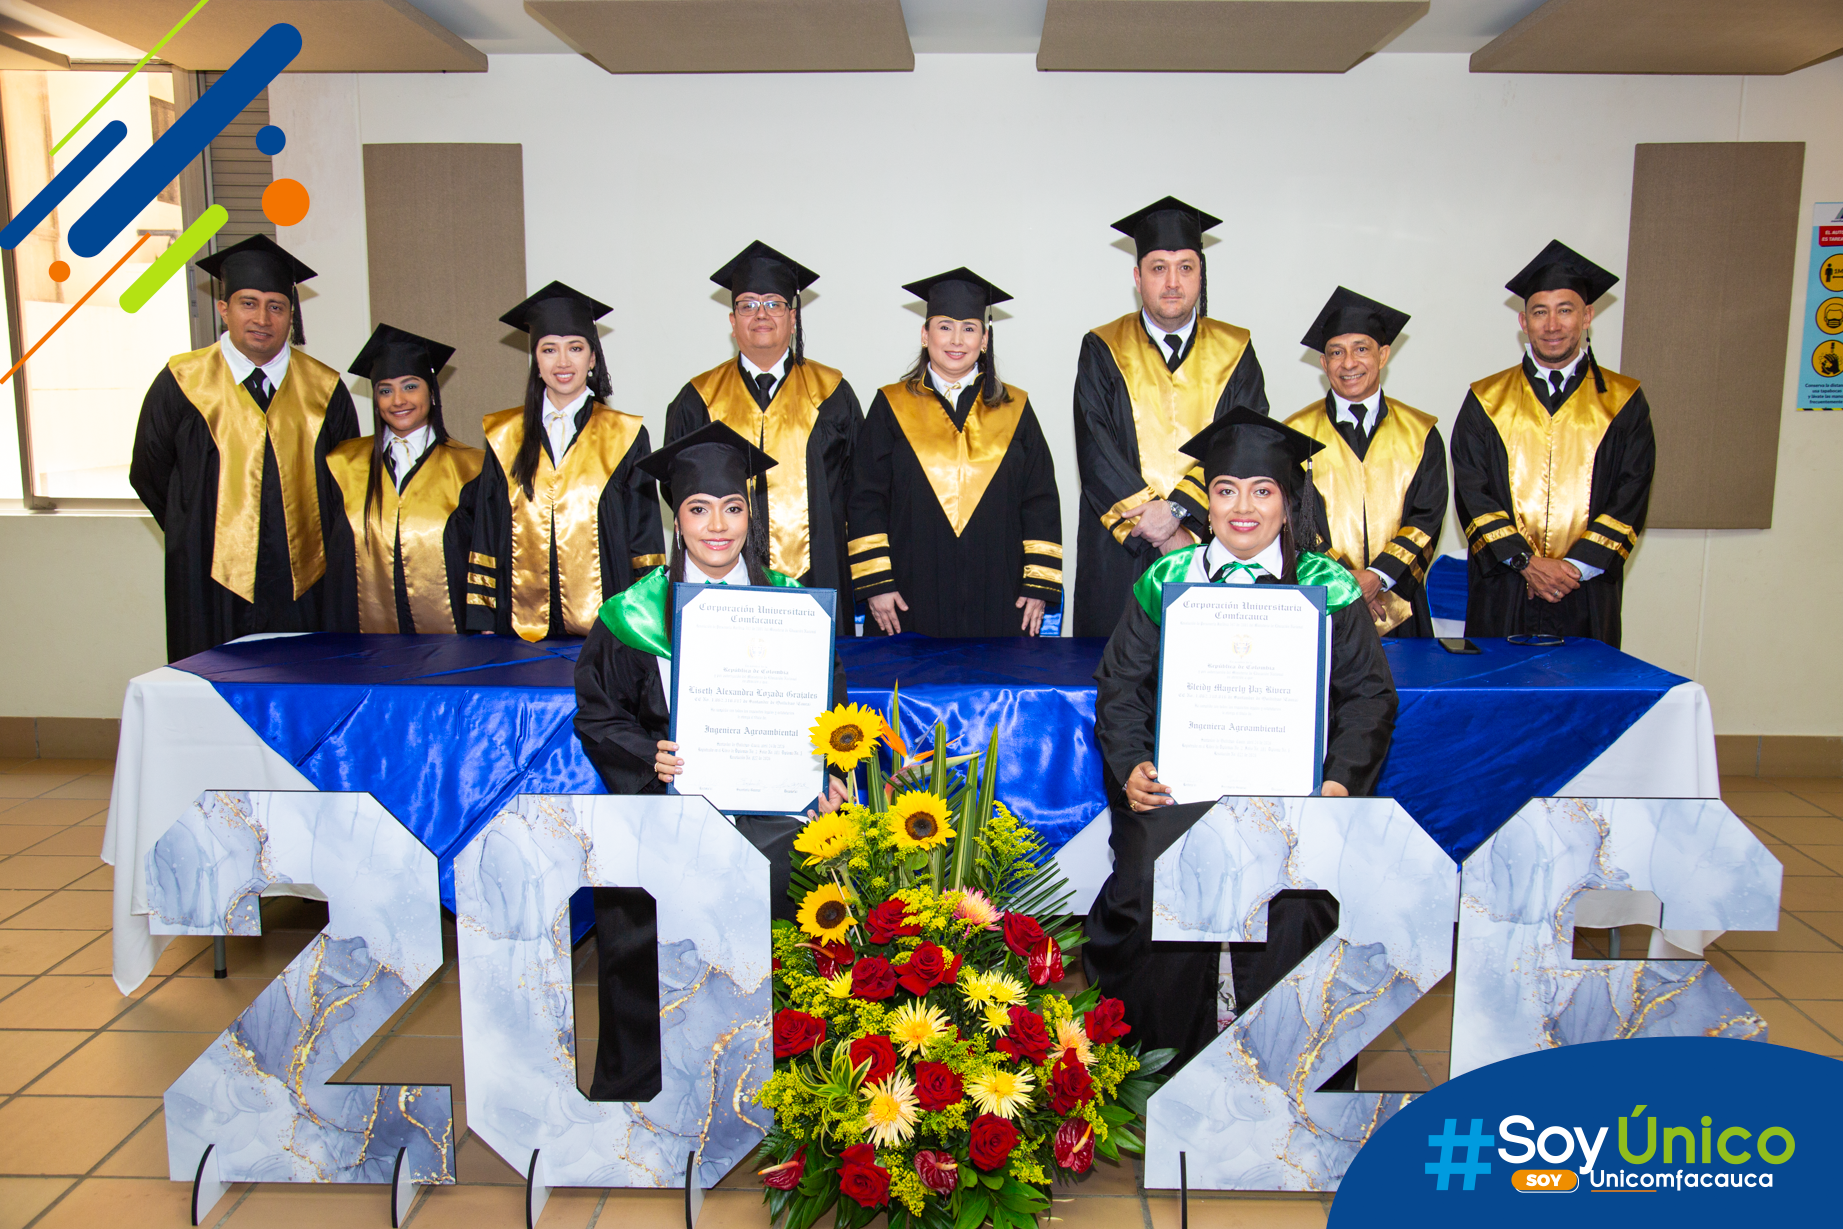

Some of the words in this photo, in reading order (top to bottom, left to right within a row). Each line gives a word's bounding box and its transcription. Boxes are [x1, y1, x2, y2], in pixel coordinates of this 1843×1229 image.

[698, 602, 755, 614] Corporación
[757, 604, 816, 617] Universitaria
[1182, 599, 1239, 610] Corporación
[1241, 601, 1302, 612] Universitaria
[730, 614, 783, 625] Comfacauca
[1214, 610, 1269, 621] Comfacauca
[1207, 662, 1236, 670] República
[688, 685, 713, 696] Liseth
[715, 686, 754, 697] Alexandra
[756, 688, 784, 699] Lozada
[786, 689, 818, 700] Grajales
[1213, 683, 1246, 694] Mayerly
[1248, 684, 1263, 694] Paz
[1265, 685, 1291, 694] Rivera
[704, 724, 741, 735] Ingeniera
[743, 726, 799, 737] Agroambiental
[1188, 720, 1226, 731] Ingeniera
[1228, 722, 1286, 733] Agroambiental
